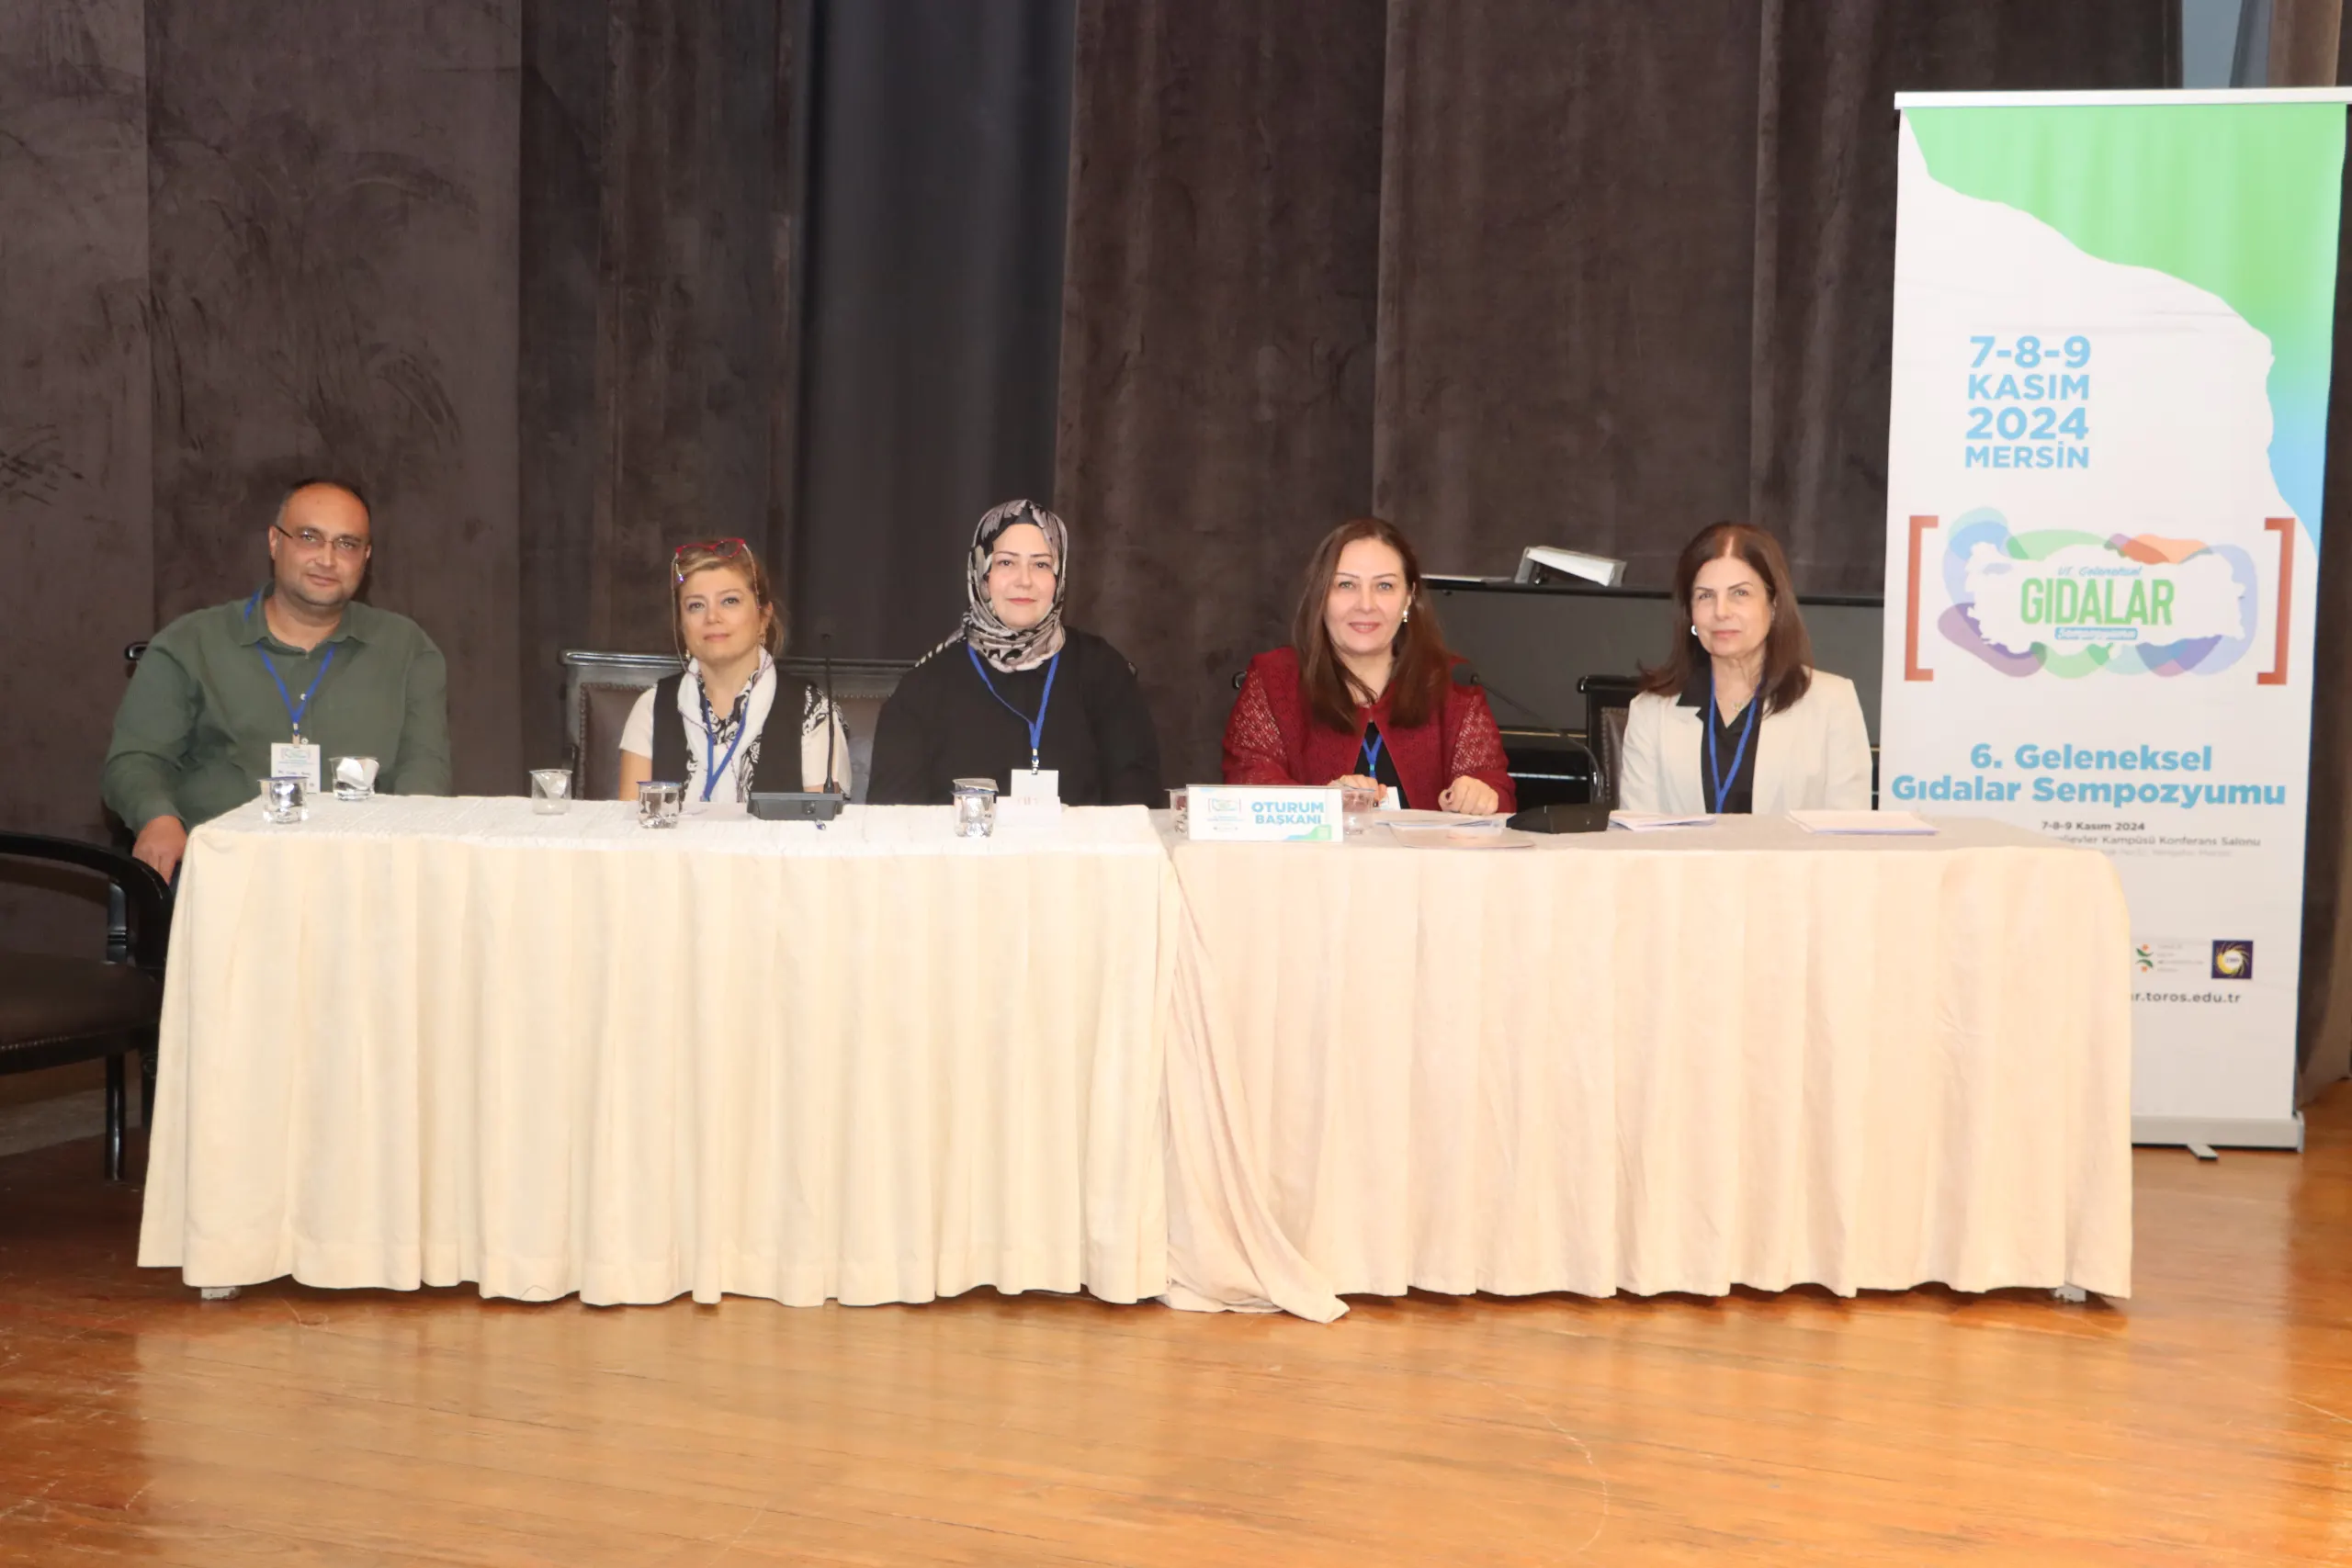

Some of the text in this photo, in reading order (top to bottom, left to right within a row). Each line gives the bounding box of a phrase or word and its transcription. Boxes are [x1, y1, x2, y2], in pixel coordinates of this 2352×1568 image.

[1969, 334, 2091, 369] 7-8-9
[1967, 373, 2090, 400] KASIM
[1965, 406, 2089, 440] 2024
[1964, 440, 2089, 468] MERSİN
[2020, 577, 2175, 626] GIDALAR
[1970, 742, 2212, 772] 6. Geleneksel
[1891, 774, 2287, 809] Gıdalar Sempozyumu
[1251, 801, 1325, 814] OTURUM
[1255, 814, 1322, 826] BAŞKANI
[2041, 821, 2145, 831] 7-8-9 Kasım 2024
[2159, 835, 2217, 846] Konferans
